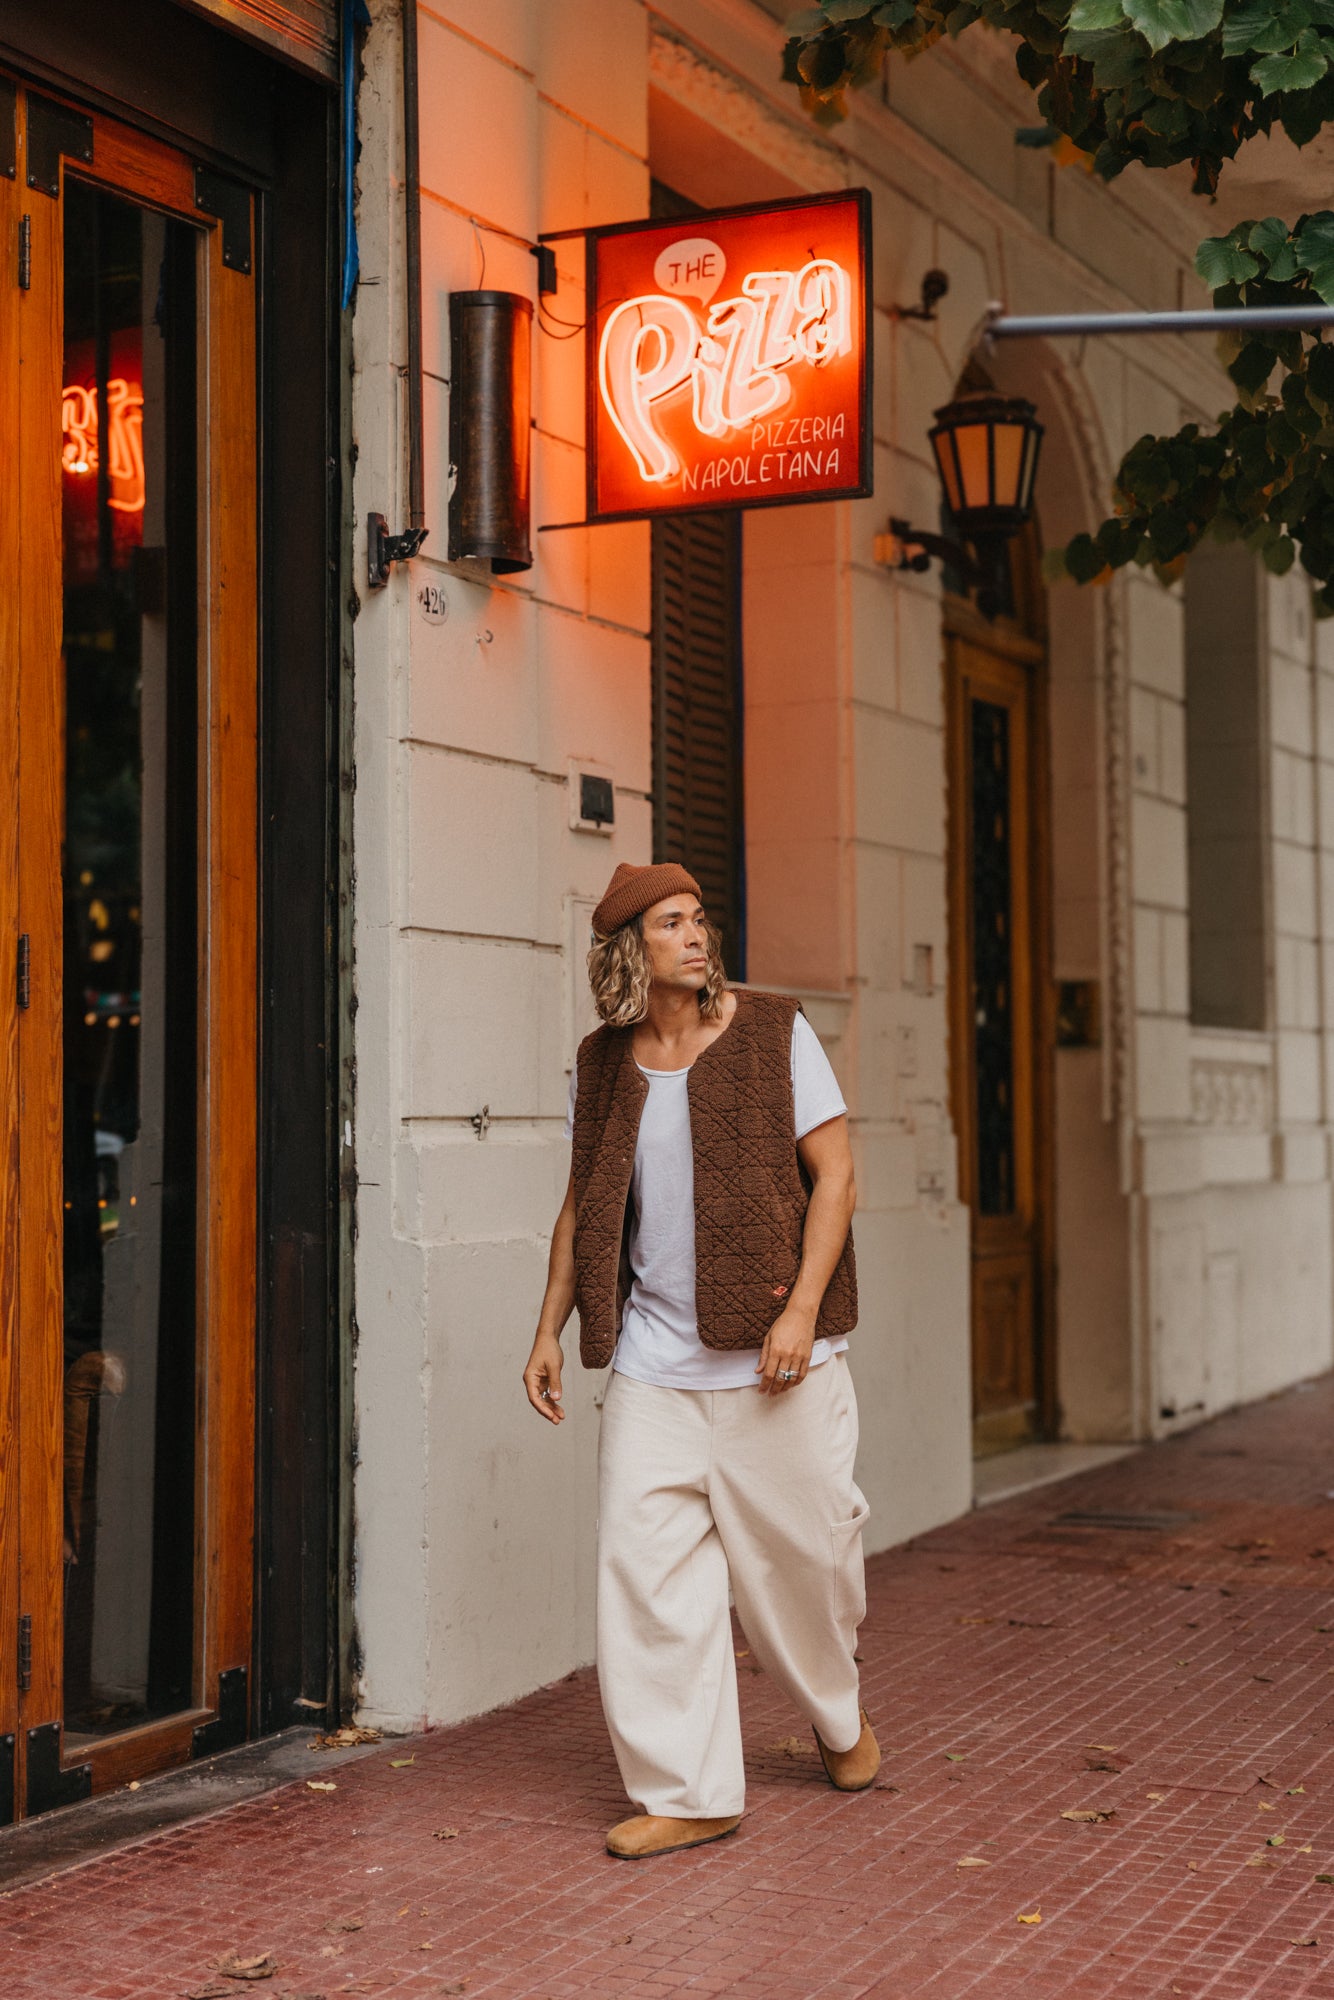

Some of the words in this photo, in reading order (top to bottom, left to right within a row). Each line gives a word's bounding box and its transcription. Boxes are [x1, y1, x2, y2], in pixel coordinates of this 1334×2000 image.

[668, 254, 716, 285] THE
[752, 413, 845, 451] PIZZERIA
[682, 448, 839, 492] NAPOLETANA
[423, 586, 446, 616] 426
